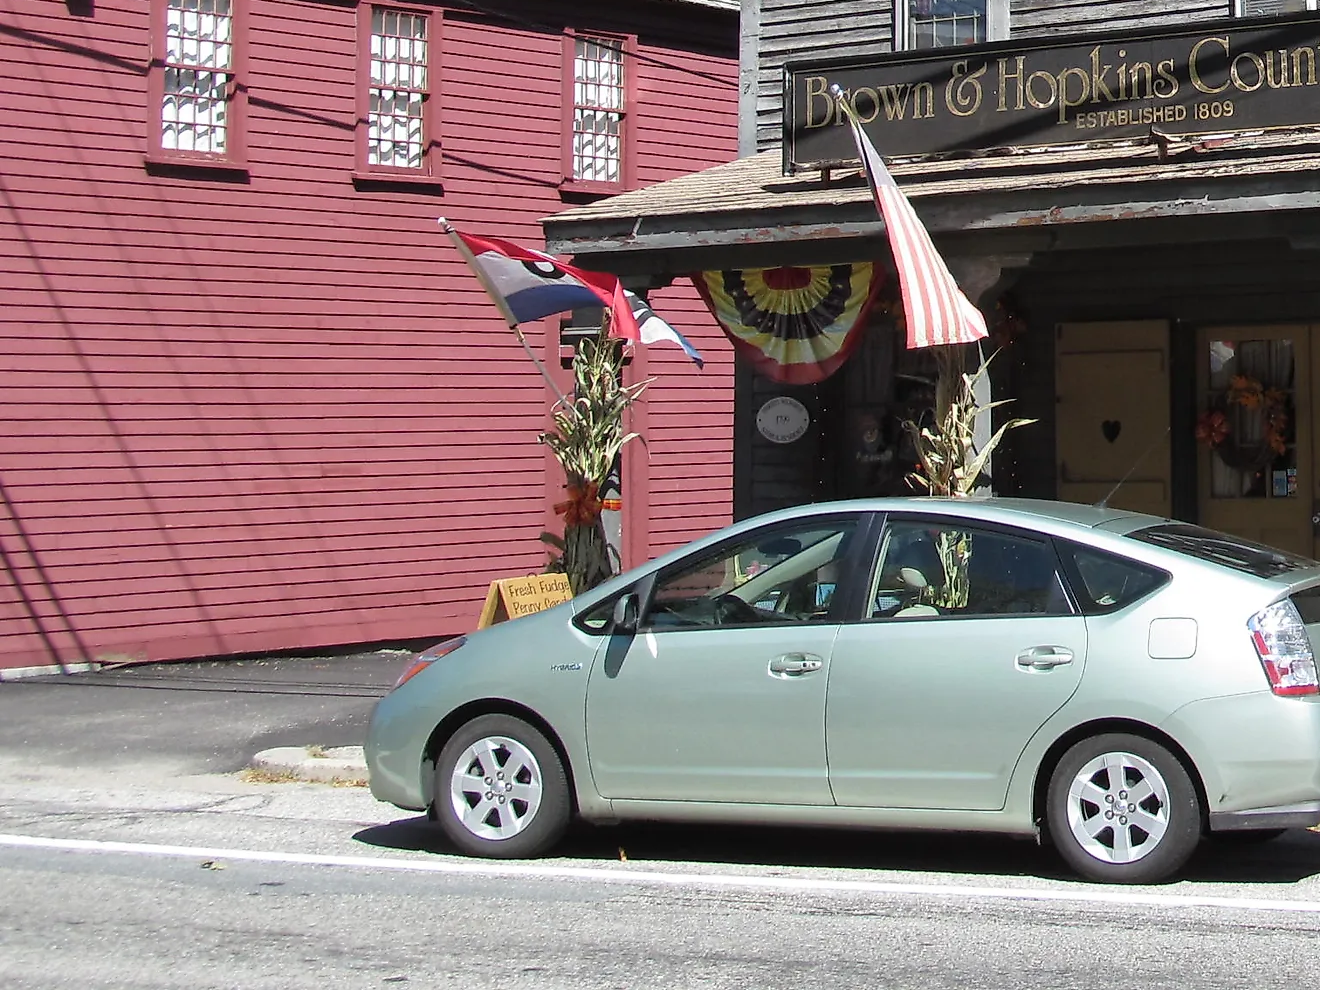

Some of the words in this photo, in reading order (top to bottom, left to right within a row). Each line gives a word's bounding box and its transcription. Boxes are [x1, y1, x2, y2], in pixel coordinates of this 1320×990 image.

[804, 75, 935, 129] Brown
[944, 59, 987, 117] &
[996, 44, 1180, 125] Hopkins
[1075, 105, 1187, 129] ESTABLISHED
[1193, 100, 1235, 121] 1809
[508, 583, 536, 598] Fresh
[539, 579, 570, 594] Fudge
[512, 601, 541, 615] Penny
